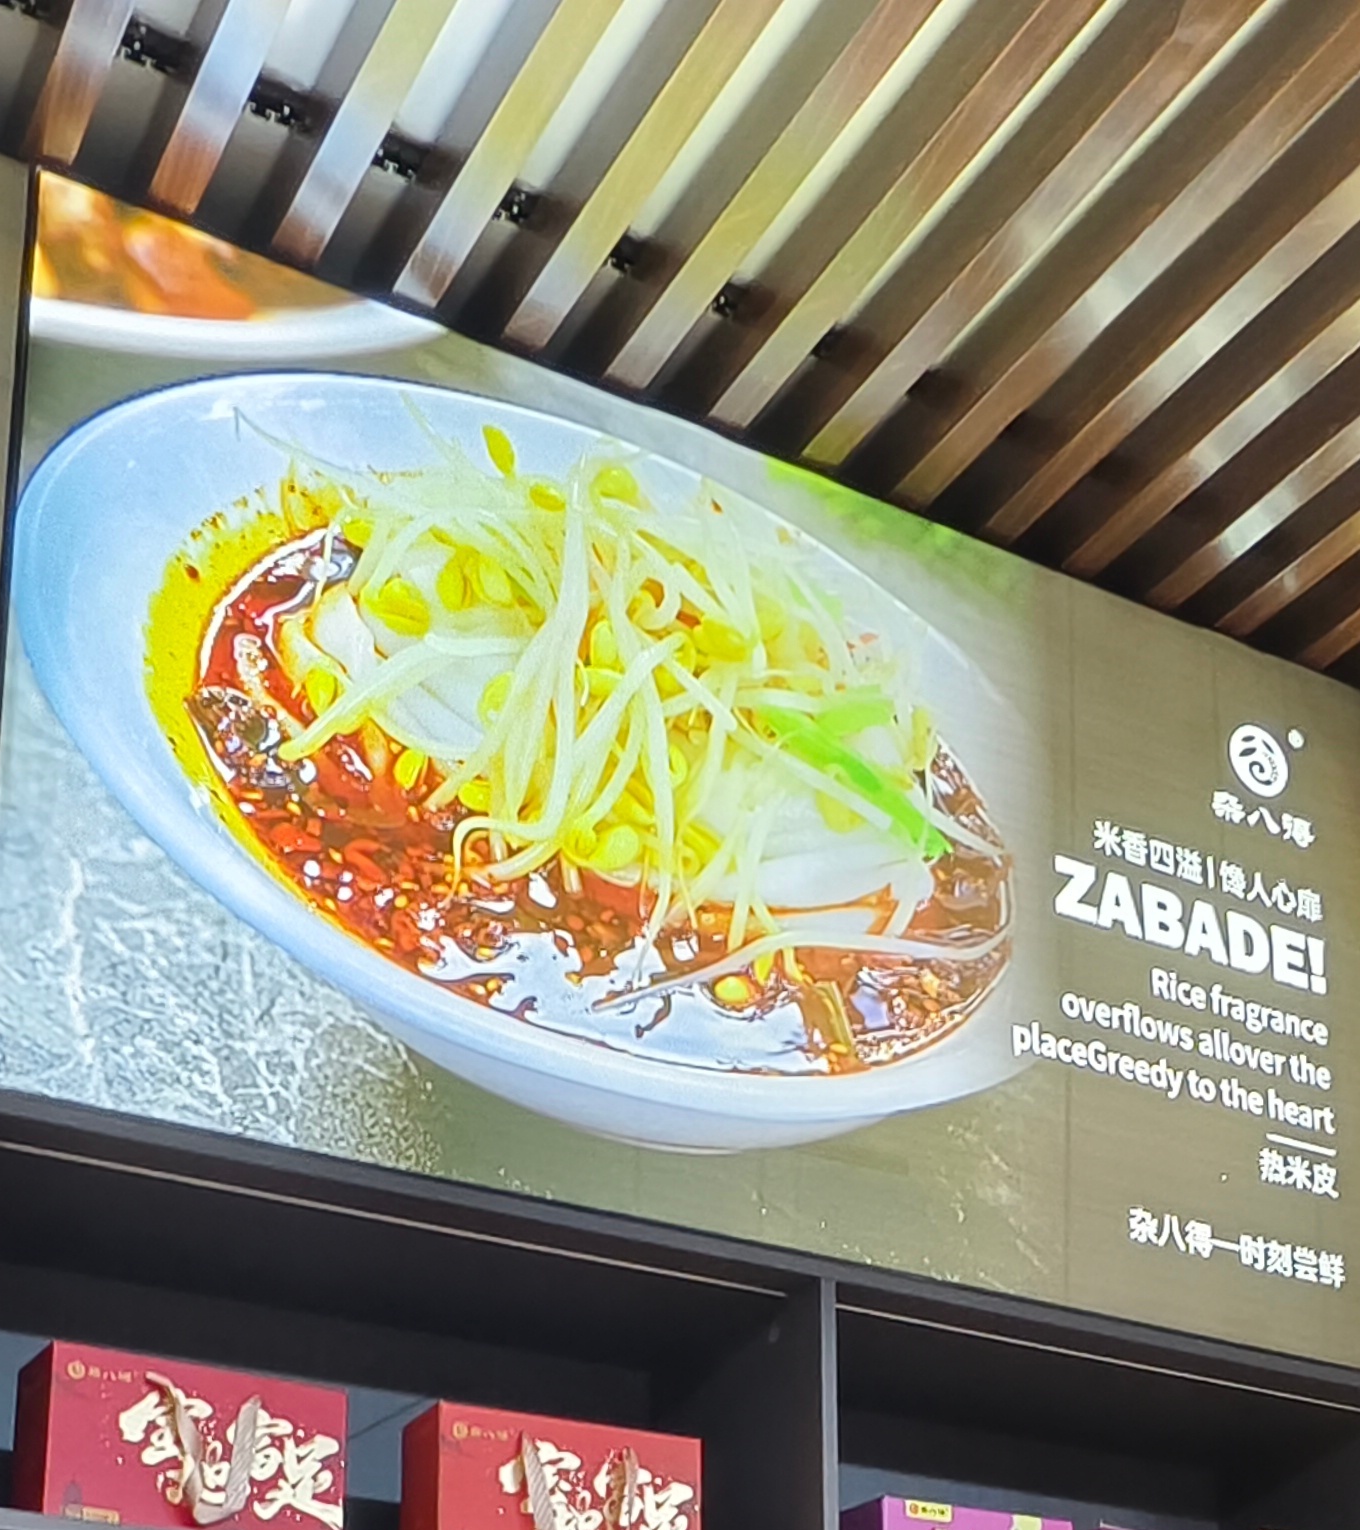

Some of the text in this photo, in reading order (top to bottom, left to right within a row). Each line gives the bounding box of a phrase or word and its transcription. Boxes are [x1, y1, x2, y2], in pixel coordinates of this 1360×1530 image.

[1054, 854, 1327, 995] ZABADE!
[1061, 992, 1332, 1090] overflows allover the
[1151, 967, 1328, 1047] Rice fragrance
[1012, 1022, 1336, 1135] placeGreedy to the heart
[1259, 1148, 1340, 1199] 热米皮
